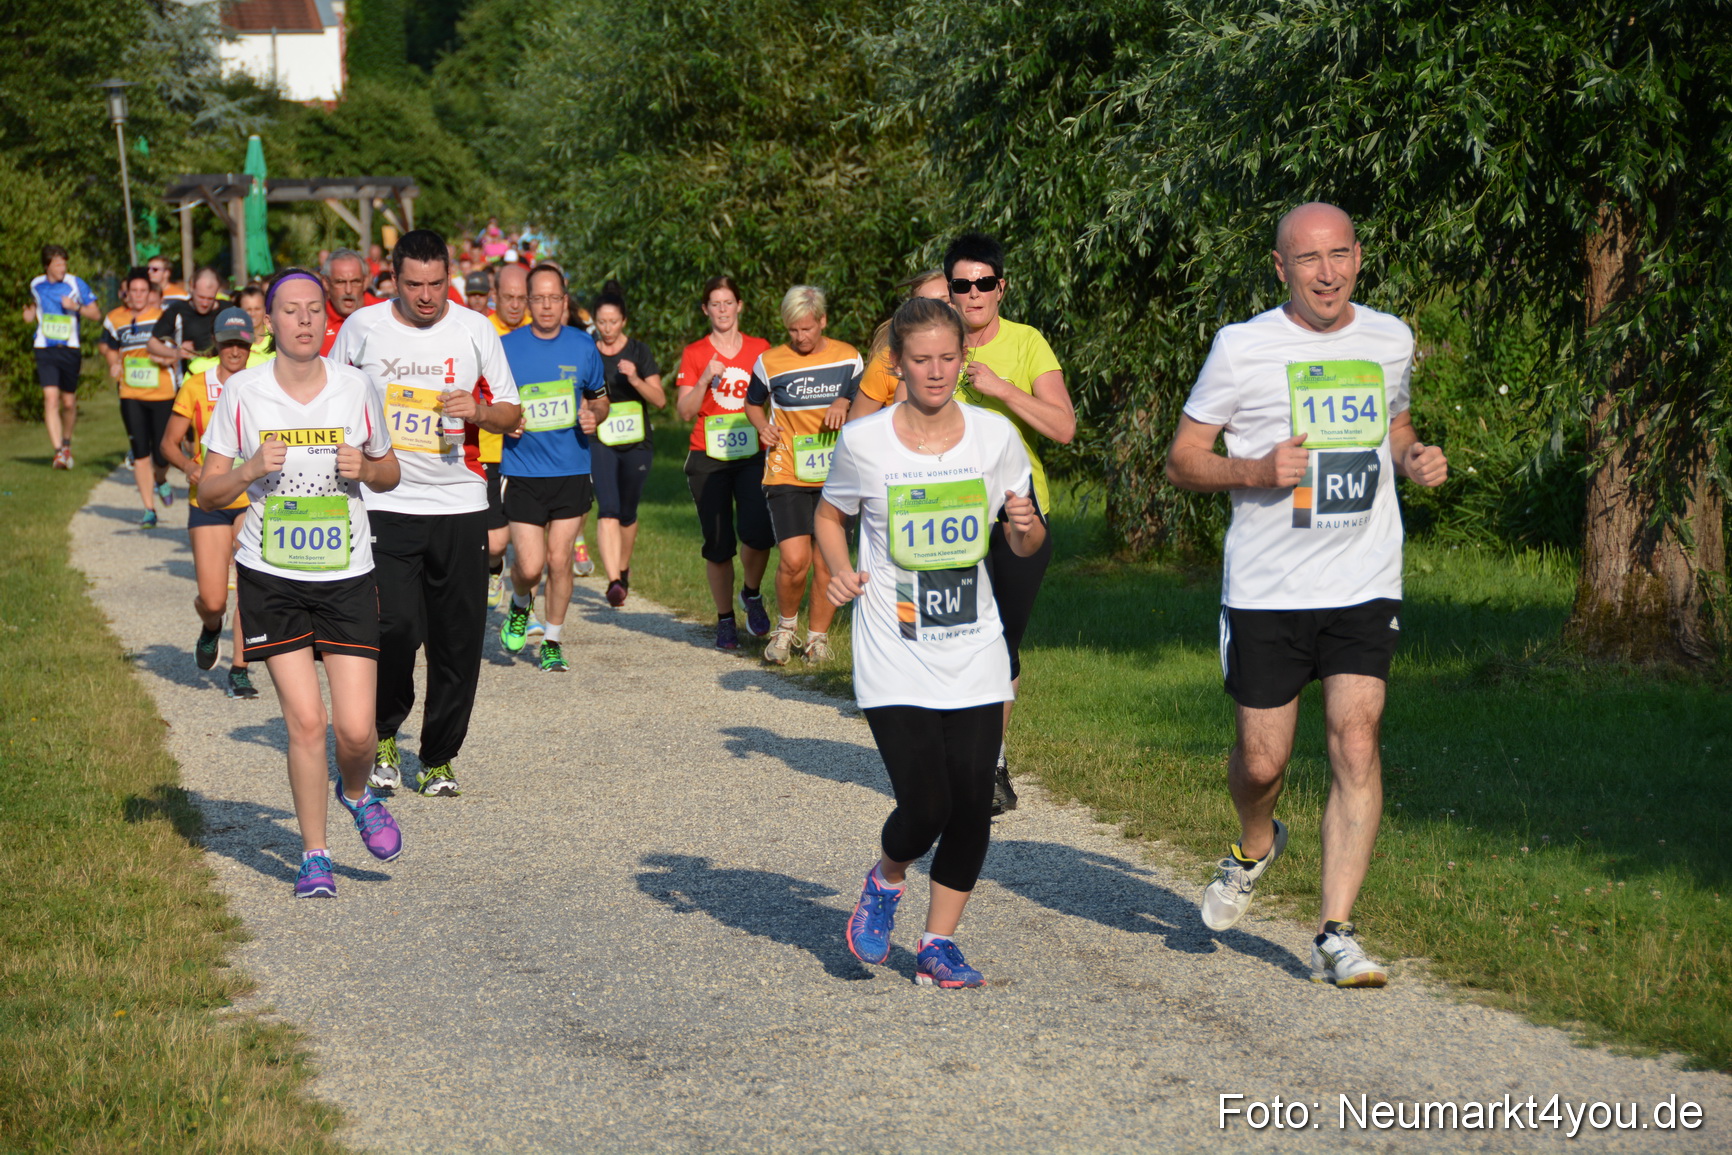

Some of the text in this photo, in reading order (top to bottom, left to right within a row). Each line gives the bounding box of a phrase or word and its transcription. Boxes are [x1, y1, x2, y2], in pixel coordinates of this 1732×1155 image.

[131, 369, 152, 380] 407
[380, 357, 456, 380] Xplus1
[717, 378, 748, 399] 48
[796, 383, 842, 395] Fischer
[800, 391, 839, 400] AUTOMOBILE
[527, 399, 569, 419] 1371
[1302, 395, 1378, 423] 1154
[607, 418, 635, 433] 102
[717, 431, 748, 448] 539
[902, 471, 923, 479] NEUE
[926, 467, 979, 477] WOHNFORMEL
[1367, 464, 1378, 472] NM
[1326, 472, 1367, 500] RW
[273, 526, 342, 550] 1008
[901, 515, 979, 547] 1160
[961, 578, 973, 586] NM
[926, 586, 961, 616] RW
[922, 626, 982, 642] RAUMWERK
